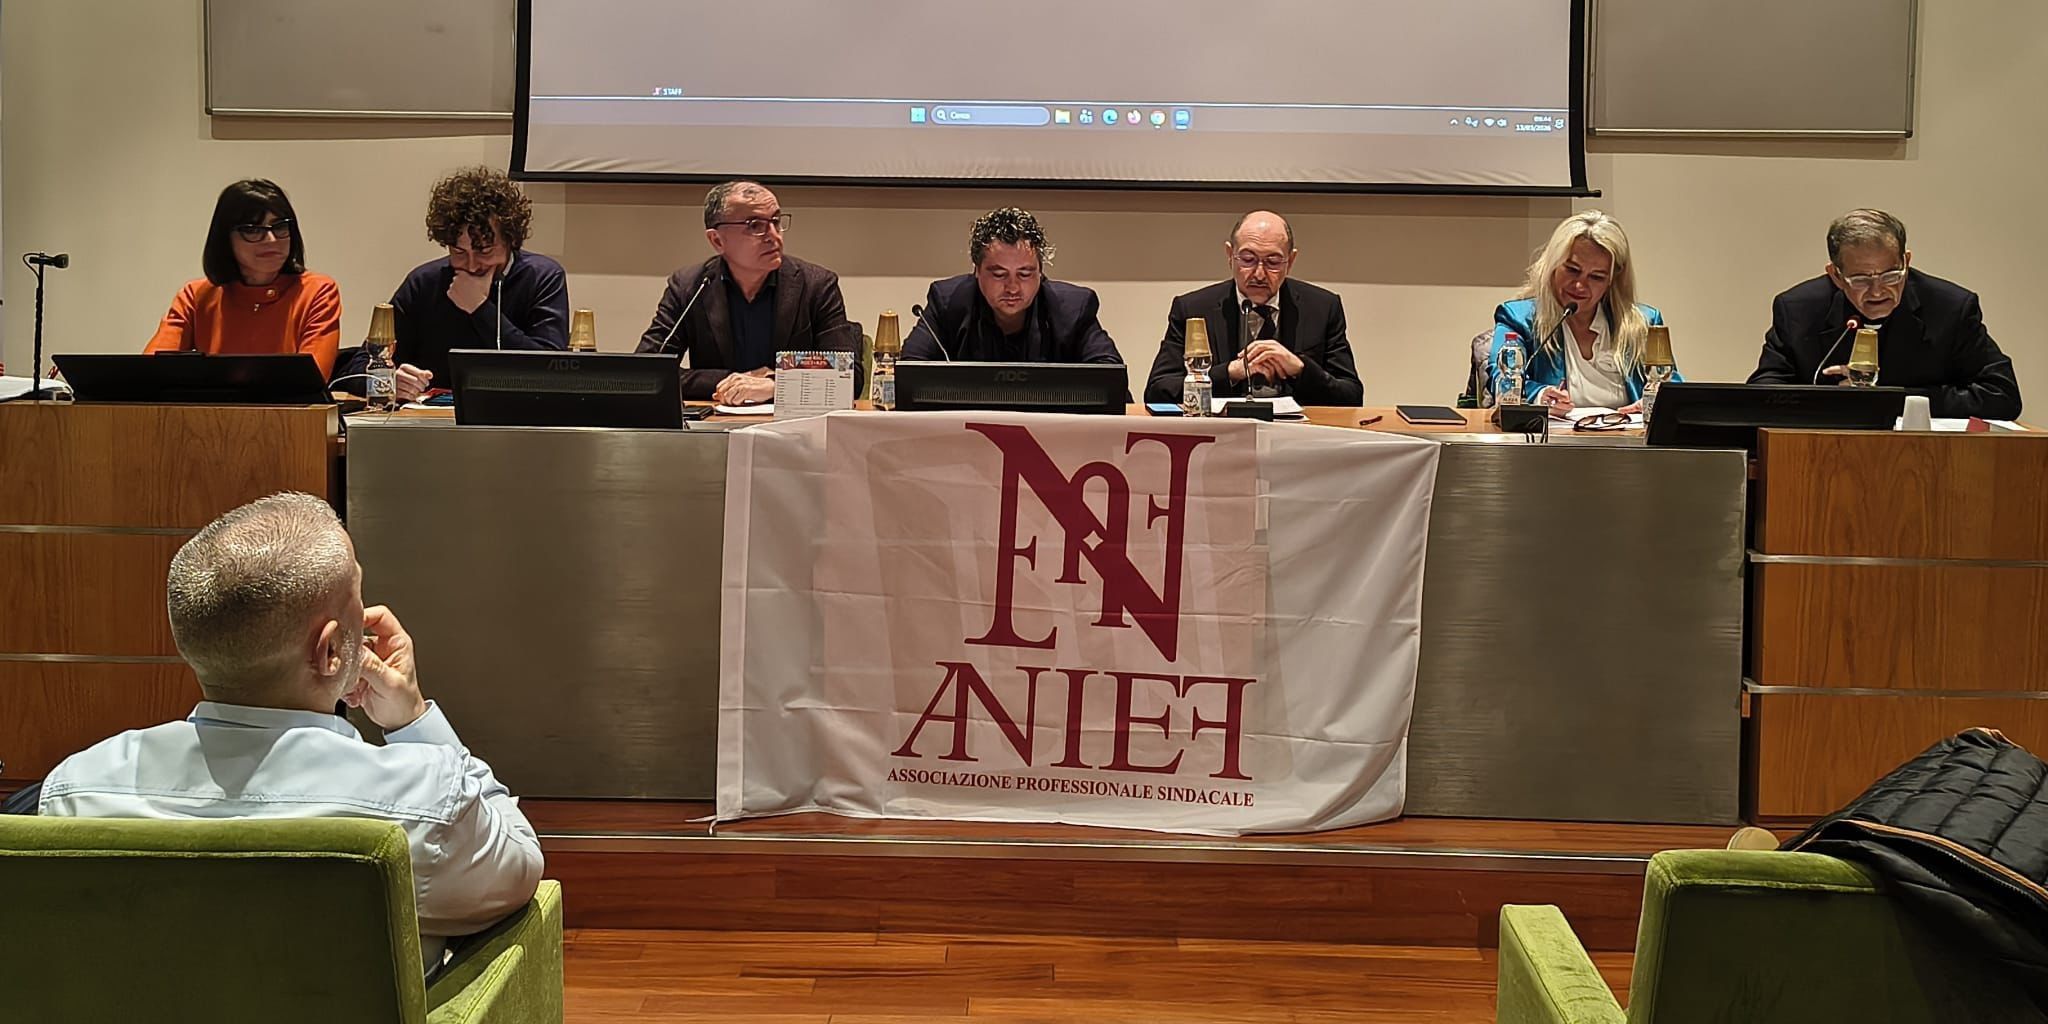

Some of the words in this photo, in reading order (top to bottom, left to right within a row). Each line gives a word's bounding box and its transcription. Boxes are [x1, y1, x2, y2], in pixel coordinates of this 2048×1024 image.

[662, 87, 683, 96] STAFF
[891, 661, 1257, 781] ANIEF
[887, 767, 1012, 790] ASSOCIAZIONE
[1015, 776, 1153, 800] PROFESSIONALE
[1157, 785, 1254, 807] SINDACALE
